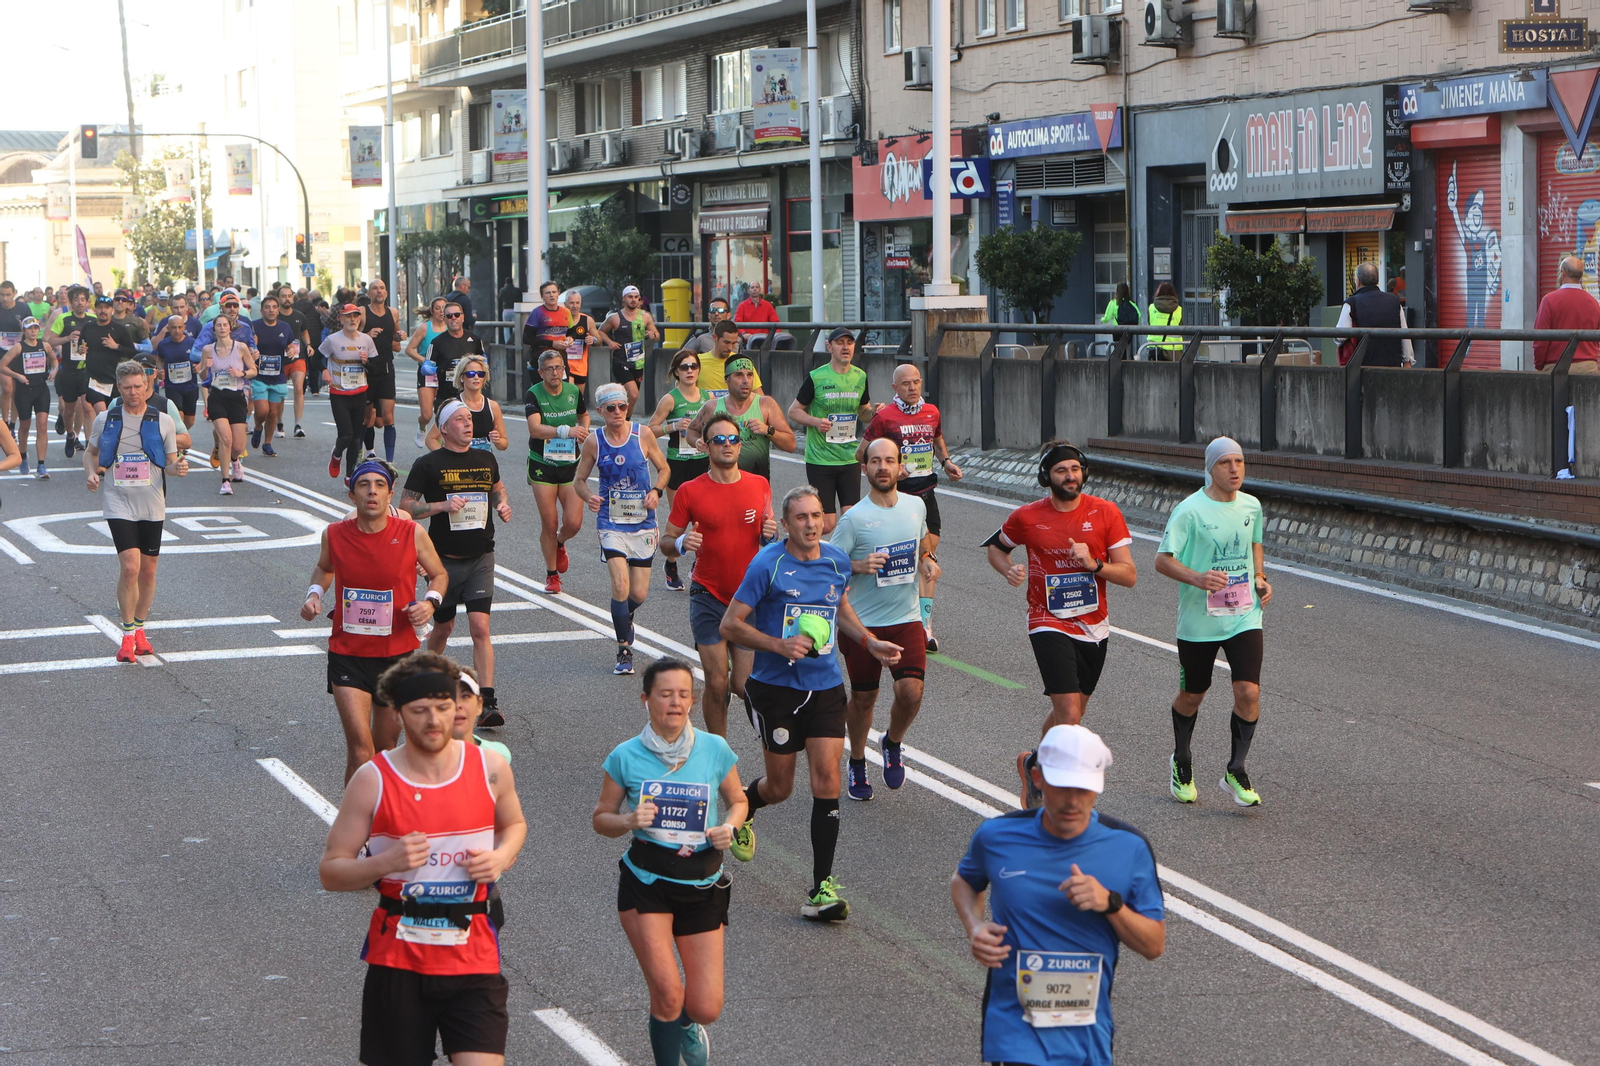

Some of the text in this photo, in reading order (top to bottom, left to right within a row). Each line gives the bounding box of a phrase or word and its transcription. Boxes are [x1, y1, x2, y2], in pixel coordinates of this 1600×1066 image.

[1512, 28, 1580, 43] HOSTAL
[1441, 83, 1484, 109] JIMENEZ
[1095, 111, 1113, 120] TALLER AD
[1007, 123, 1090, 149] AUTOCLIMA SPORT, S.L.
[748, 182, 768, 198] TATTOO
[710, 217, 729, 231] TATTOO
[735, 216, 757, 229] PIERCING
[443, 472, 460, 482] 10K
[891, 543, 915, 553] ZURICH
[887, 567, 907, 576] SEVILLA
[1063, 576, 1089, 584] ZURICH
[360, 593, 387, 601] ZURICH
[1062, 590, 1082, 599] 12502
[1063, 599, 1084, 608] JOSEPH
[359, 608, 376, 616] 7597
[665, 786, 701, 797] ZURICH
[661, 805, 688, 817] 11727
[661, 820, 686, 829] CONSO
[428, 885, 469, 896] ZURICH
[413, 917, 445, 928] WALLEY
[1047, 958, 1091, 970] ZURICH
[1046, 984, 1071, 994] 9072
[1026, 999, 1090, 1008] JORGE ROMERO
